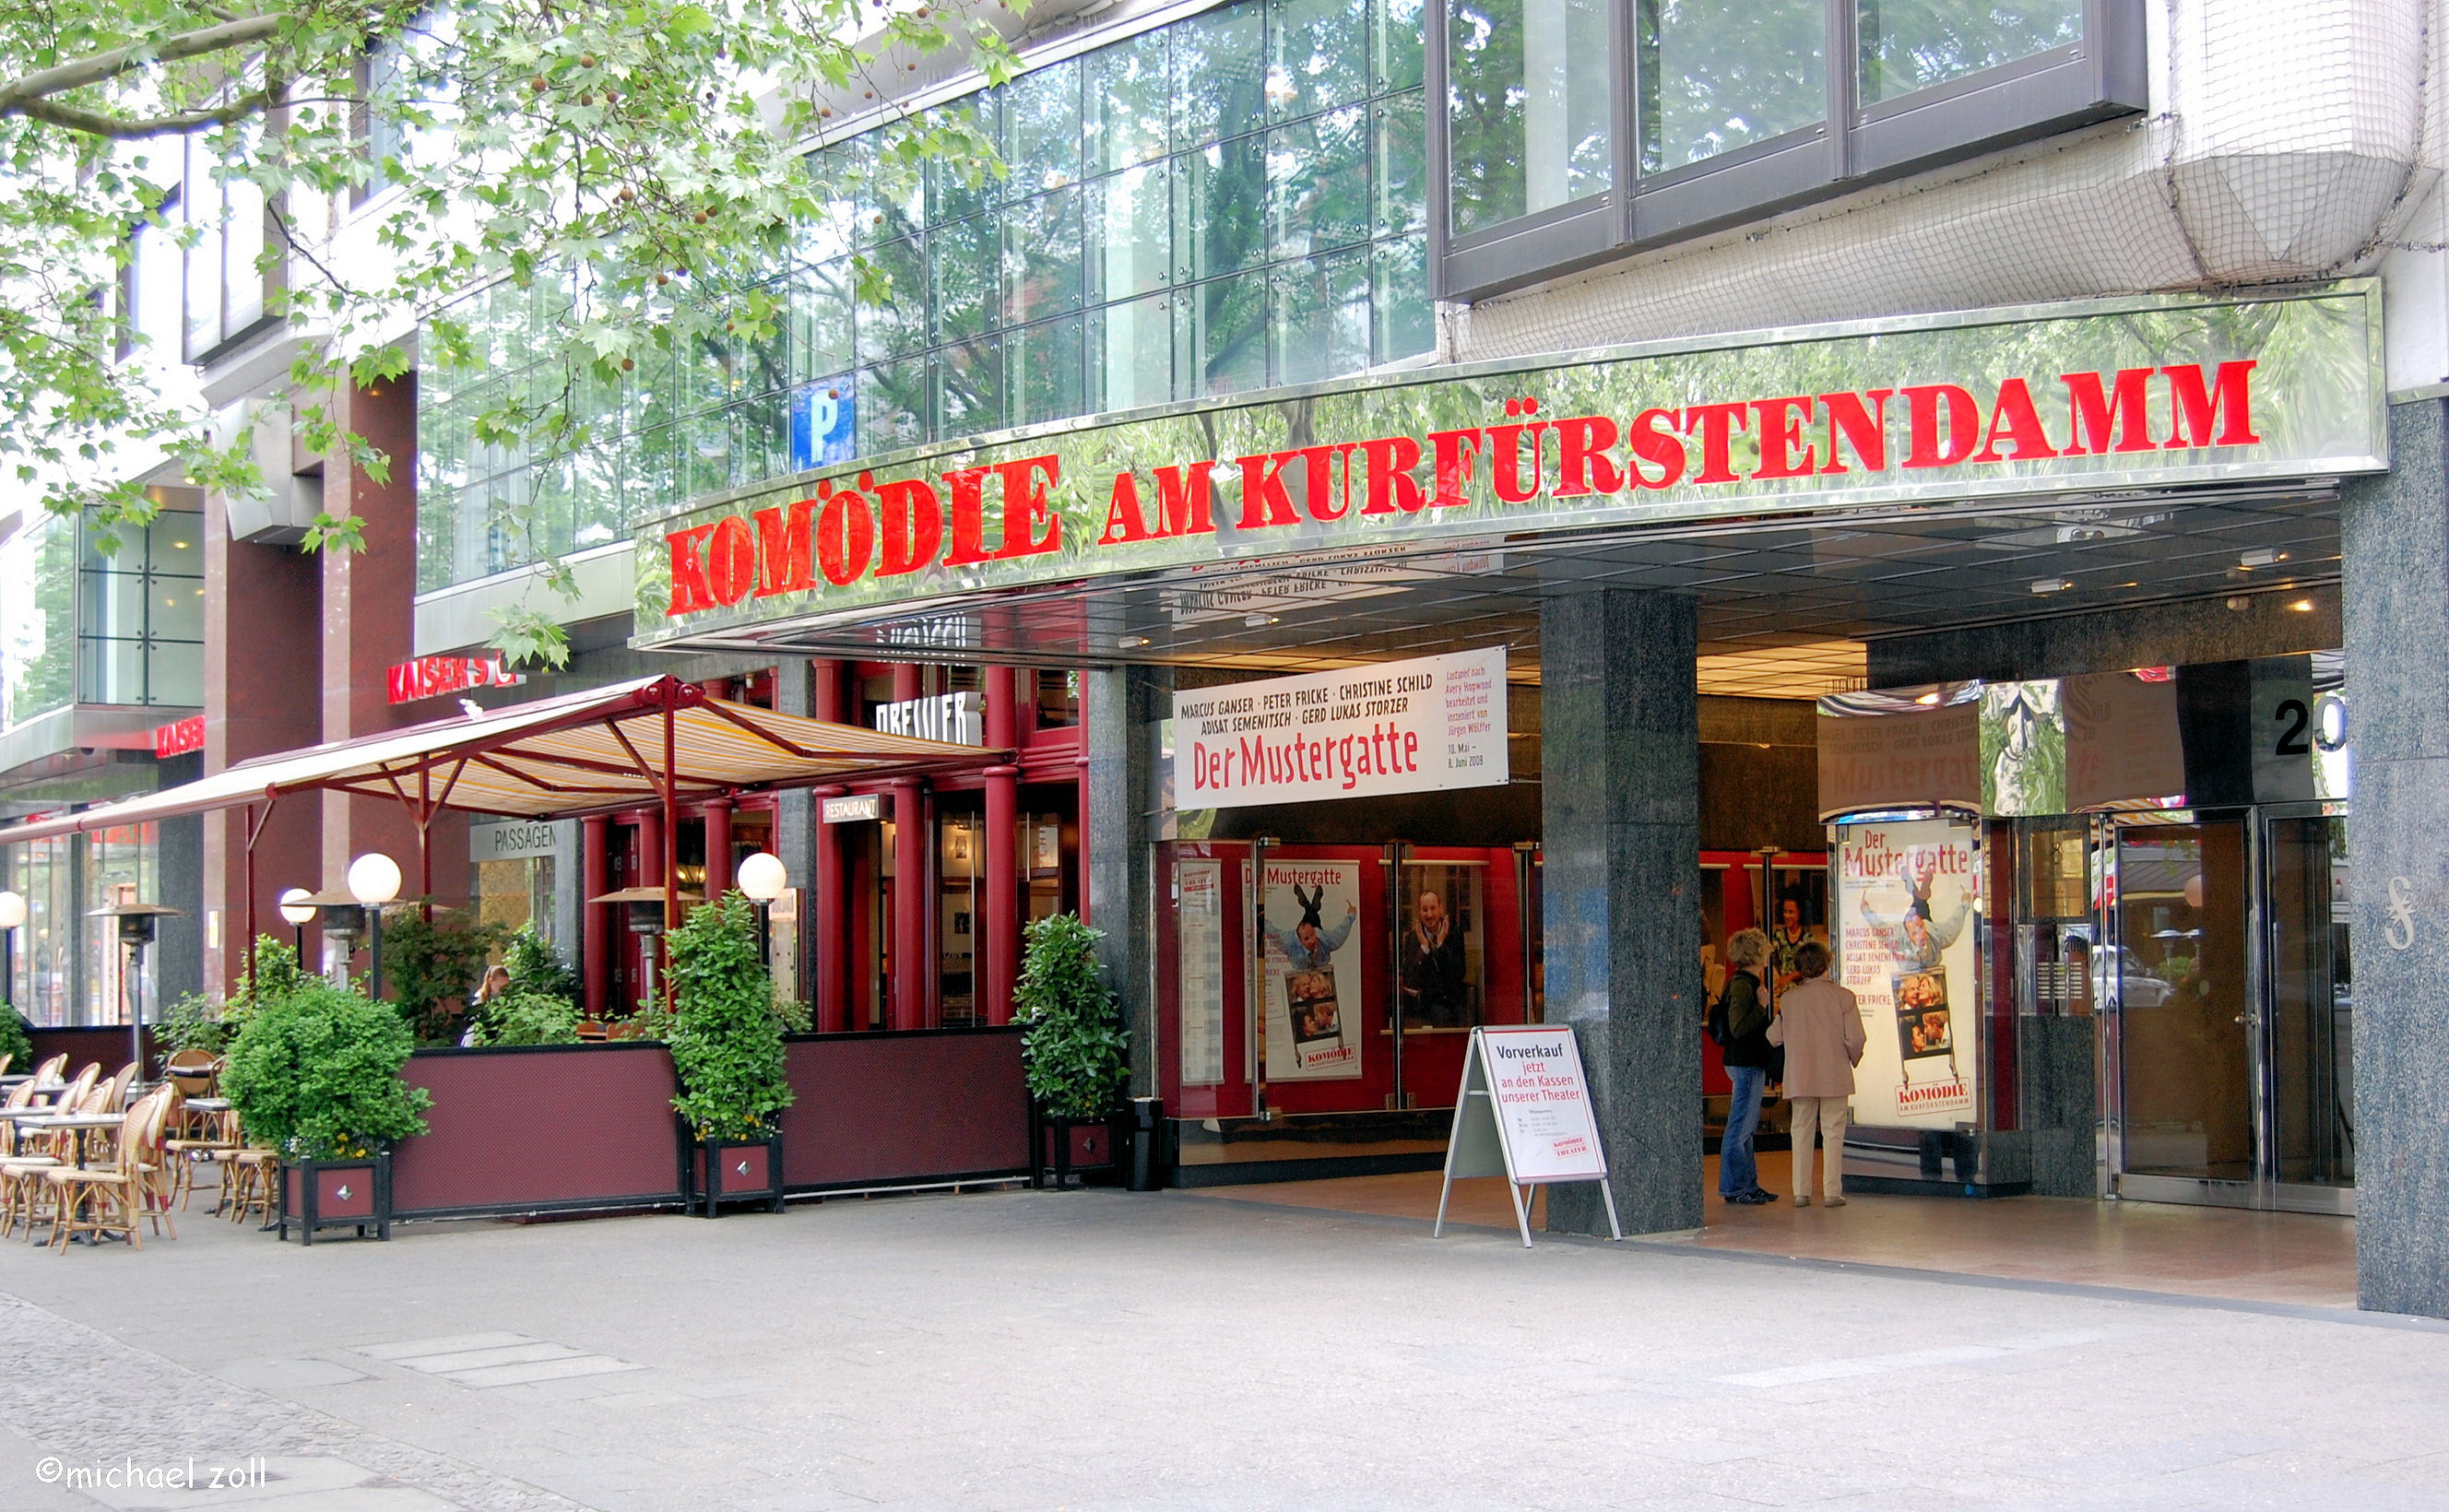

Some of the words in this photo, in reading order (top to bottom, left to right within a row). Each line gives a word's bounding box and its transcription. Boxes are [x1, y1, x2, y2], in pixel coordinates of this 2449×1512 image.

[810, 391, 838, 462] P
[666, 454, 1062, 617] KOMÖDIE
[1097, 460, 1217, 545] AM
[1235, 360, 2260, 530] KURFÜRSTENDAMM
[1181, 702, 1214, 719] MARCUS
[1218, 697, 1254, 715] GANSER
[1263, 692, 1291, 711] PETER
[1295, 687, 1329, 706] FRICKE
[1340, 679, 1392, 701] CHRISTINE
[1397, 674, 1433, 693] SCHILD
[1201, 718, 1228, 737] ADISAT
[1233, 711, 1292, 733] SEMENITSCH
[1302, 708, 1327, 725] GERD
[1331, 703, 1361, 721] LUKAS
[1365, 697, 1408, 717] STORZER
[2275, 698, 2348, 755] 20
[1194, 741, 1236, 790] Der
[1239, 722, 1418, 790] Mustergatte
[1458, 743, 1470, 753] Mai
[825, 799, 876, 819] RESTAURANT
[495, 825, 557, 852] PASSAGEN
[1865, 830, 1887, 849] Der
[1844, 844, 1968, 882] Mustergatte
[1267, 868, 1342, 888] Mustergatte
[1497, 1043, 1563, 1059] Vorverkauf
[1522, 1061, 1545, 1075] jetzt
[1501, 1079, 1513, 1088] an
[1516, 1076, 1535, 1088] den
[1538, 1075, 1574, 1087] Kassen
[1501, 1093, 1540, 1104] unserer
[1542, 1090, 1579, 1103] Theater
[1899, 1083, 1969, 1104] KOMÖDIE
